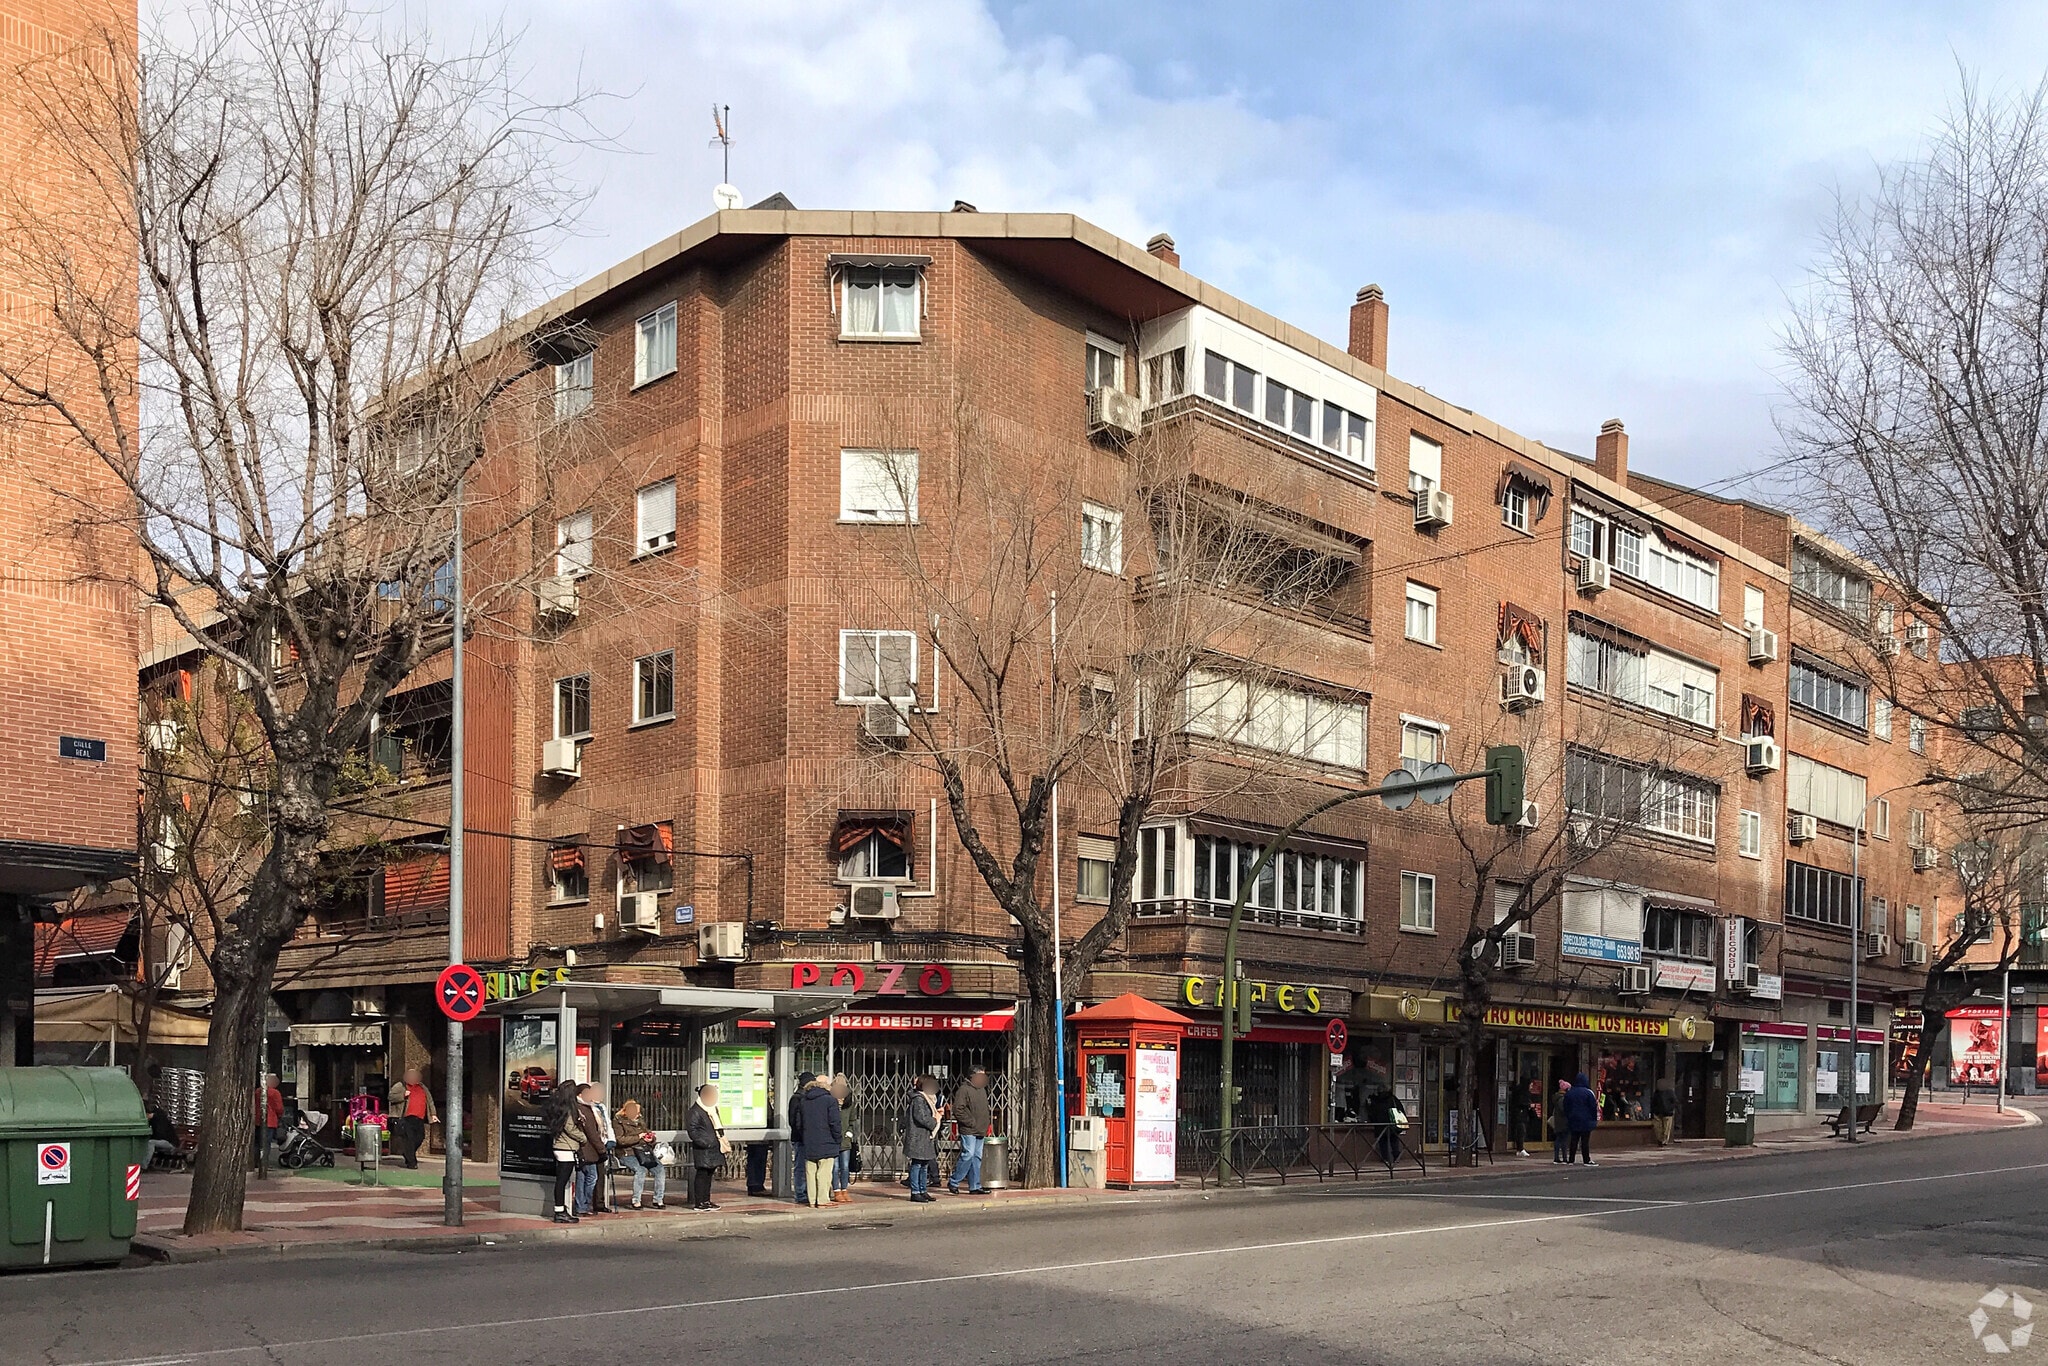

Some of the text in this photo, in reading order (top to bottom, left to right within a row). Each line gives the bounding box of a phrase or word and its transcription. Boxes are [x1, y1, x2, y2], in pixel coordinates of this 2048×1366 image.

[73, 740, 92, 749] CALLE
[75, 749, 91, 757] REAL
[792, 963, 952, 996] POZO
[832, 1016, 873, 1028] POZO
[879, 1016, 933, 1028] DESDE
[942, 1016, 983, 1029] 1932
[1451, 1004, 1510, 1025] CTRO
[1514, 1008, 1590, 1030] COMERCIAL
